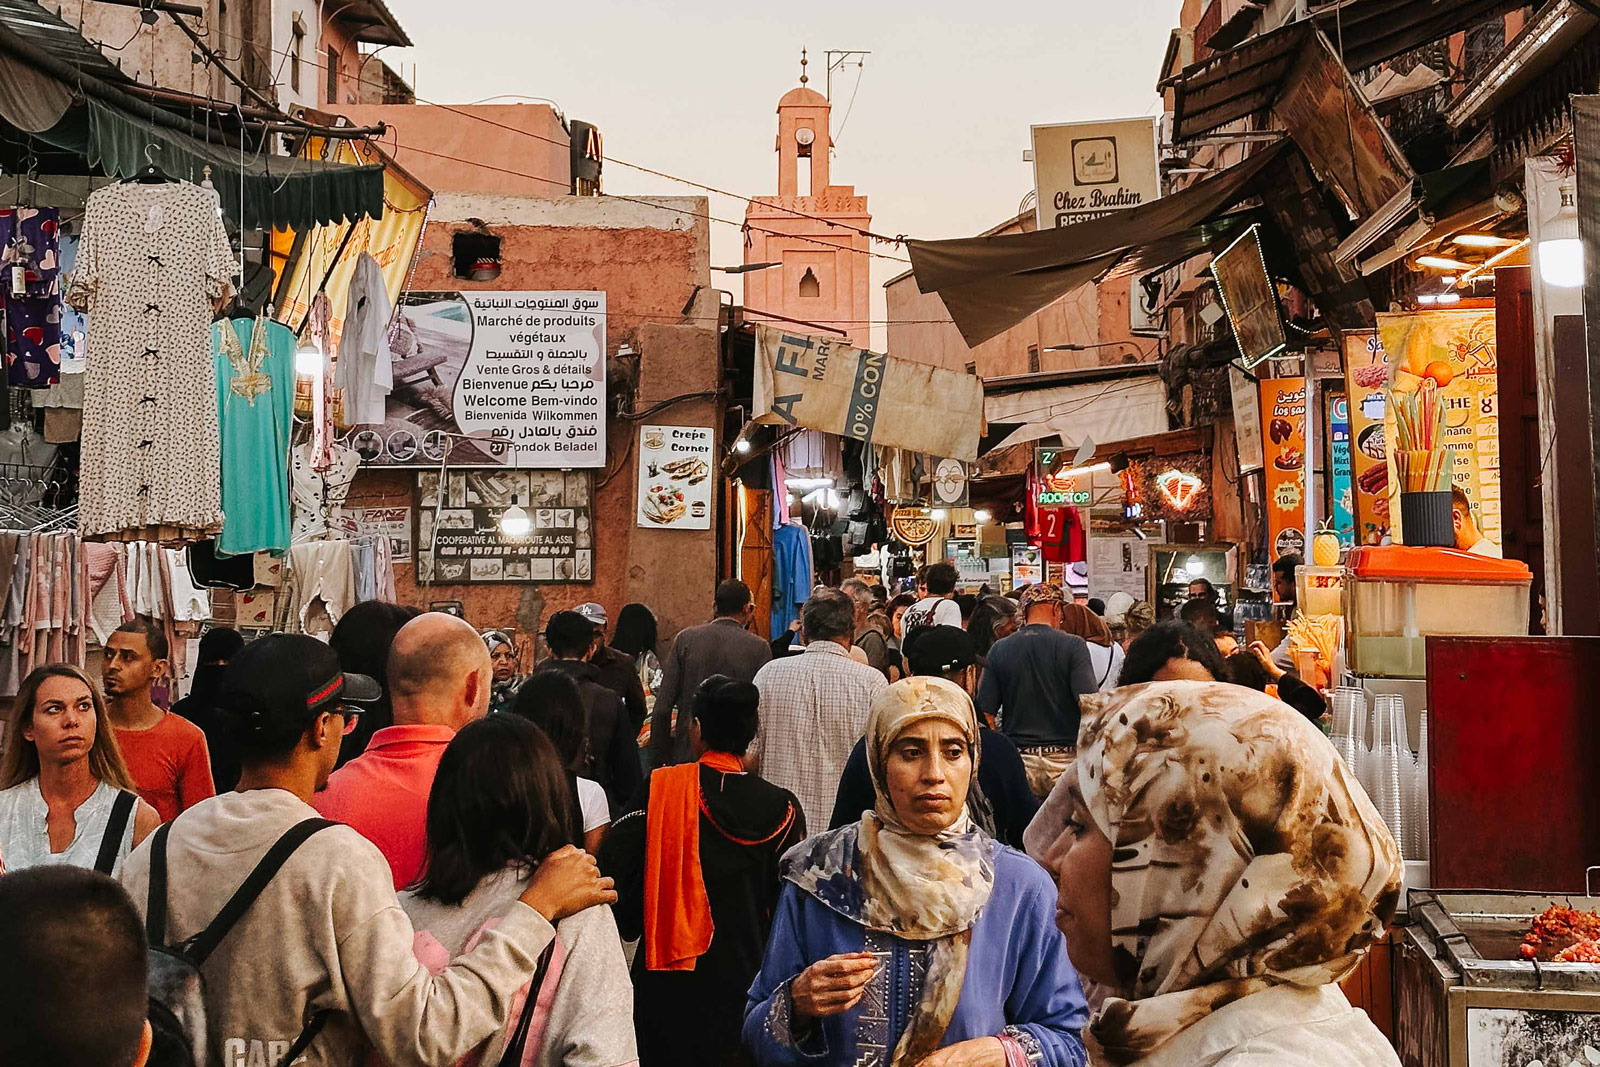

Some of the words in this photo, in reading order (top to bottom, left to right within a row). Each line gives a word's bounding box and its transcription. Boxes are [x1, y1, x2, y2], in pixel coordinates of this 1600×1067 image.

[1054, 191, 1086, 210] Chez
[1089, 187, 1142, 208] Brahim
[474, 298, 512, 311] النباتية
[515, 298, 568, 310] المنتوجات
[572, 298, 599, 310] سوق
[477, 315, 523, 326] Marché
[526, 315, 541, 326] de
[544, 315, 596, 328] produits
[509, 331, 566, 345] végétaux
[486, 349, 533, 361] التقسيط
[536, 350, 544, 361] و
[548, 349, 587, 361] بالجملة
[476, 365, 509, 375] Vente
[512, 365, 540, 375] Gros
[543, 365, 551, 375] &
[553, 364, 592, 375] détails
[463, 379, 528, 390] Bienvenue
[531, 379, 557, 392] بكم
[561, 379, 594, 392] مرحبا
[464, 395, 527, 406] Welcome
[531, 395, 598, 406] Bem-vindo
[465, 410, 527, 420] Bienvenida
[532, 410, 598, 420] Wilkommen
[491, 425, 514, 439] رقم
[519, 426, 561, 439] بالعادل
[566, 425, 597, 438] فندق
[491, 443, 503, 452] 27
[507, 442, 550, 452] Fondok
[554, 442, 597, 452] Beladel
[671, 443, 709, 452] Corner
[1039, 492, 1090, 503] ROOFTOP
[1047, 514, 1056, 537] 2
[436, 536, 487, 545] COOPERATIVE
[487, 536, 497, 545] AL
[545, 536, 554, 545] AL
[555, 536, 574, 545] ASSIL
